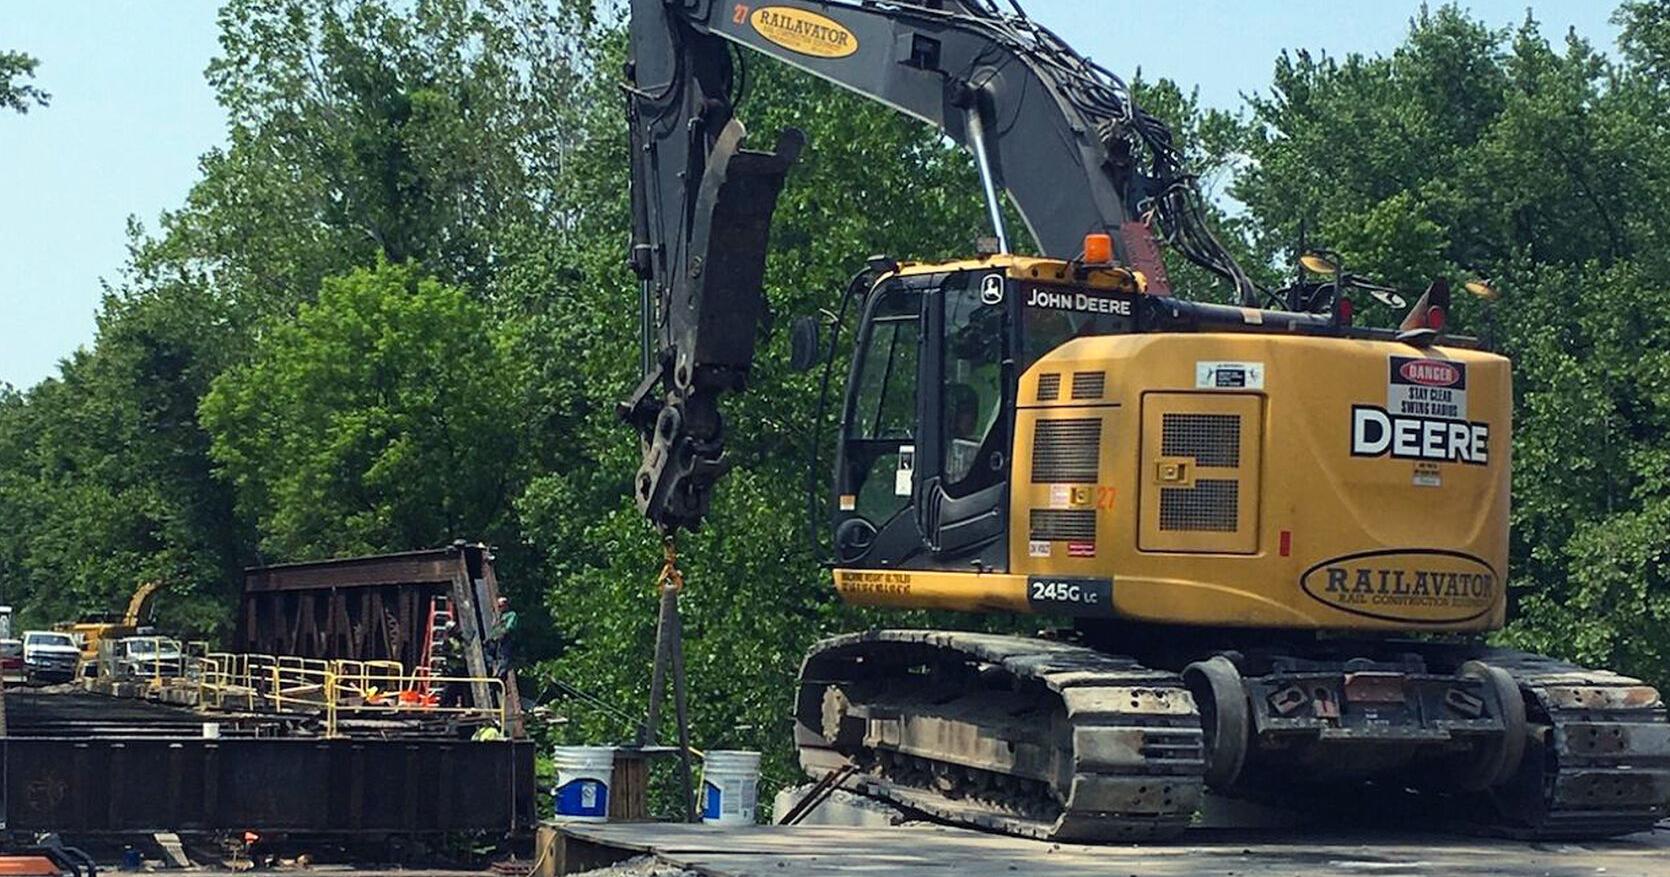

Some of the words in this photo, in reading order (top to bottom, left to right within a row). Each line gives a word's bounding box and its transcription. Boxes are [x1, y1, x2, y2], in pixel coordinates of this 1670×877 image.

[733, 4, 748, 24] 27
[760, 11, 849, 46] RAILAVATOR
[1027, 289, 1072, 309] JOHN
[1075, 294, 1131, 315] DEERE
[1408, 364, 1452, 381] DANGER
[1408, 387, 1428, 400] STAY
[1430, 388, 1453, 402] CLEAR
[1401, 401, 1430, 415] SWING
[1431, 403, 1458, 417] RADIUS
[1353, 406, 1488, 464] DEERE
[1097, 486, 1117, 511] 27
[1032, 582, 1080, 601] 245G
[1083, 592, 1099, 603] LC
[1325, 567, 1492, 598] RAILAVATOR
[1338, 593, 1368, 604] RAIL
[1371, 595, 1450, 608] CONSTRUCTION
